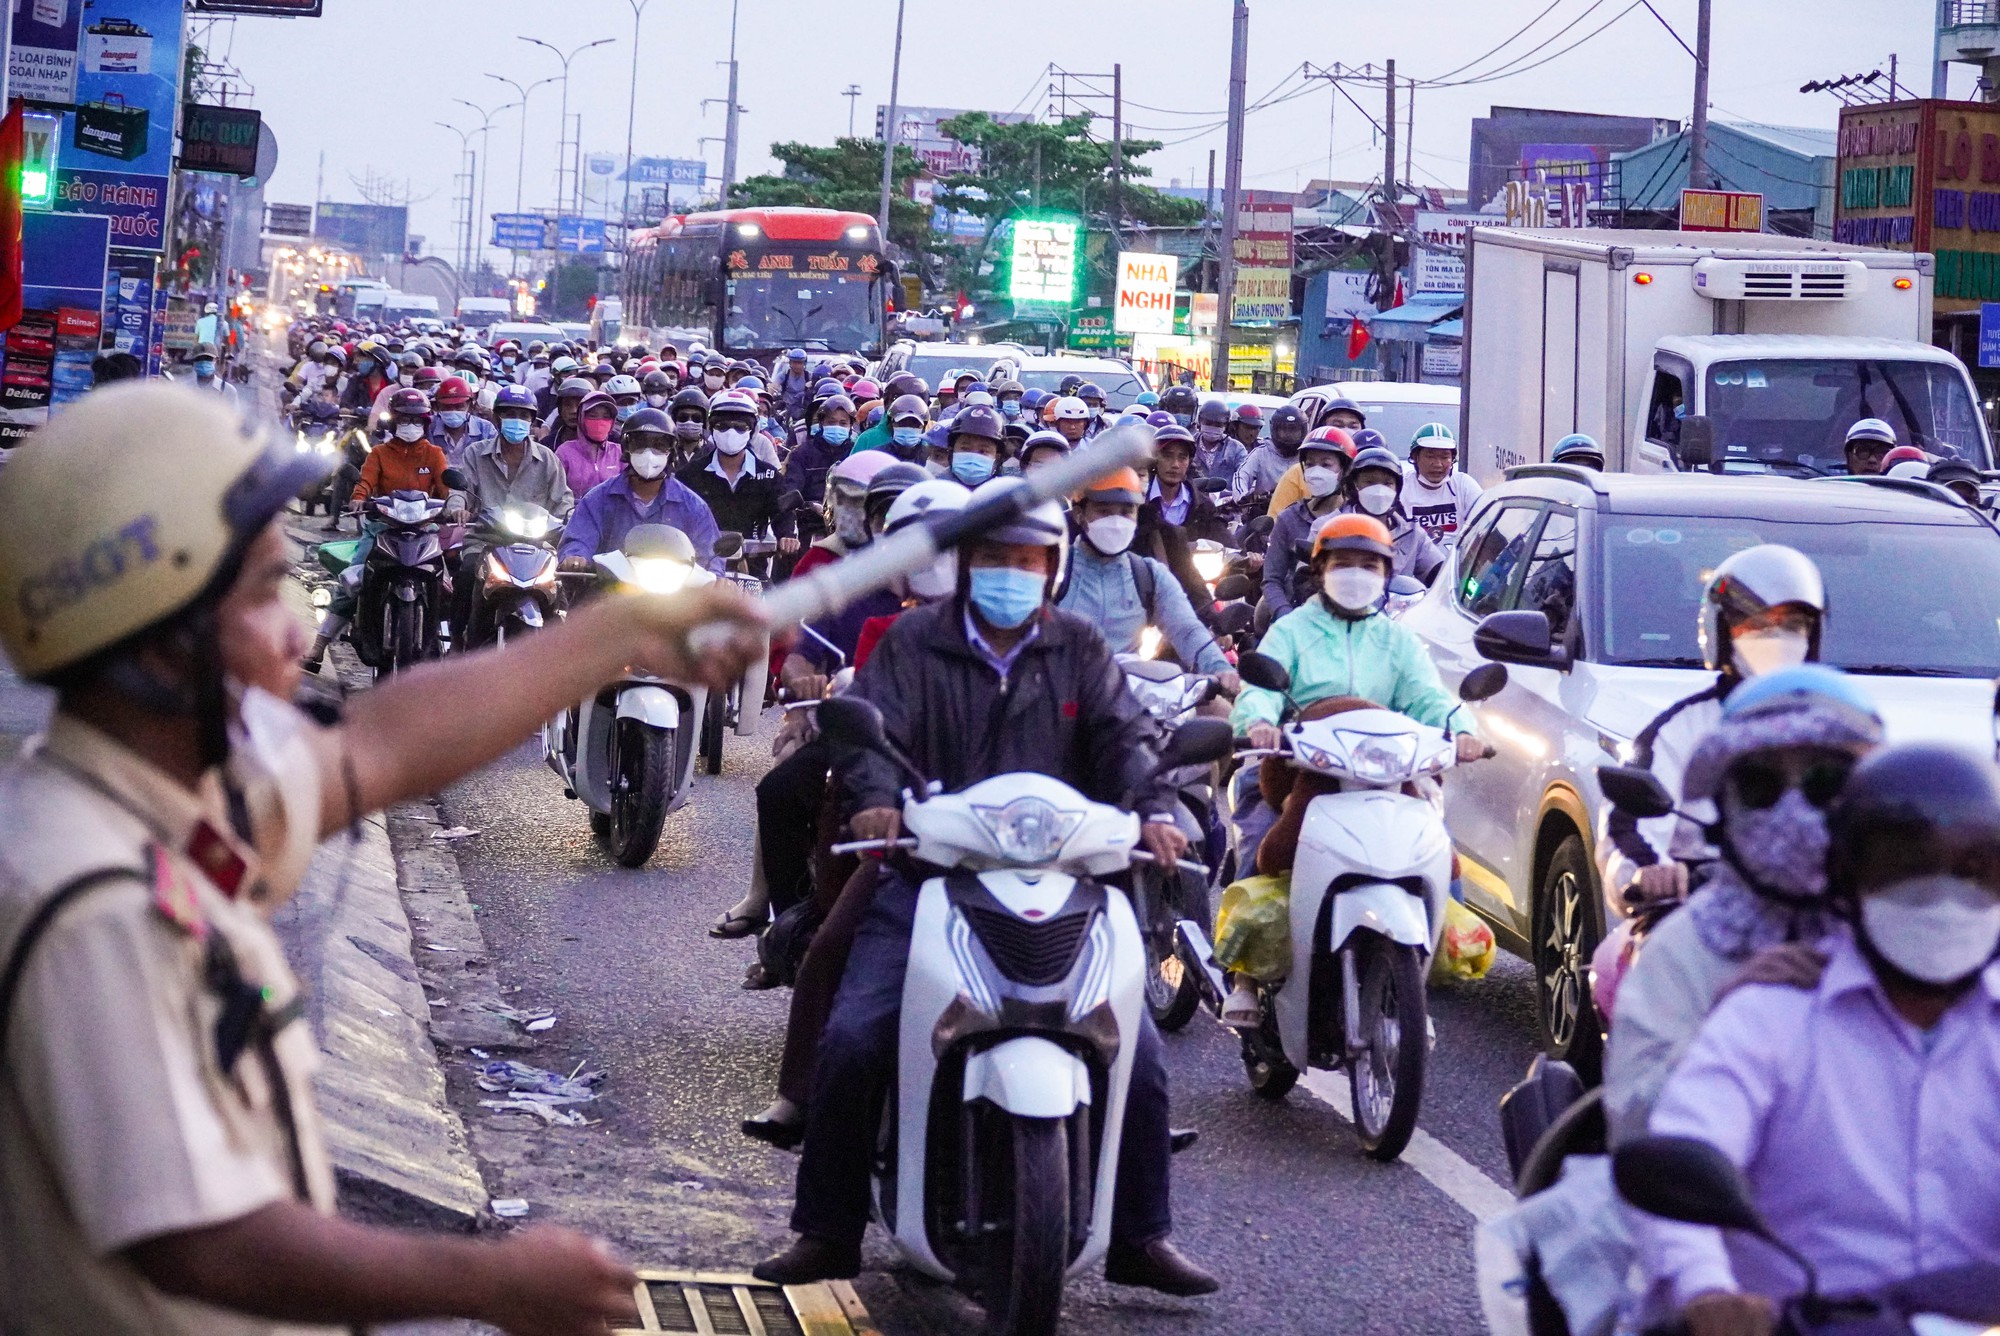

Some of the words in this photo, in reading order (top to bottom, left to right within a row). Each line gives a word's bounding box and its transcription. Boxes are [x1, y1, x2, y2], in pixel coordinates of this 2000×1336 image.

[641, 164, 668, 177] THE
[671, 167, 700, 179] ONE
[55, 175, 97, 202] BẢO
[102, 182, 157, 208] HÀNH
[758, 254, 794, 269] ANH
[808, 250, 849, 271] TUẤN
[1747, 263, 1799, 272] HWASUNG
[1805, 263, 1845, 273] THERMO
[121, 282, 135, 290] GS
[1120, 286, 1172, 311] NGHỈ
[66, 317, 97, 328] Enimac
[121, 313, 142, 326] GS
[115, 341, 130, 350] GS
[5, 387, 45, 400] Delkor
